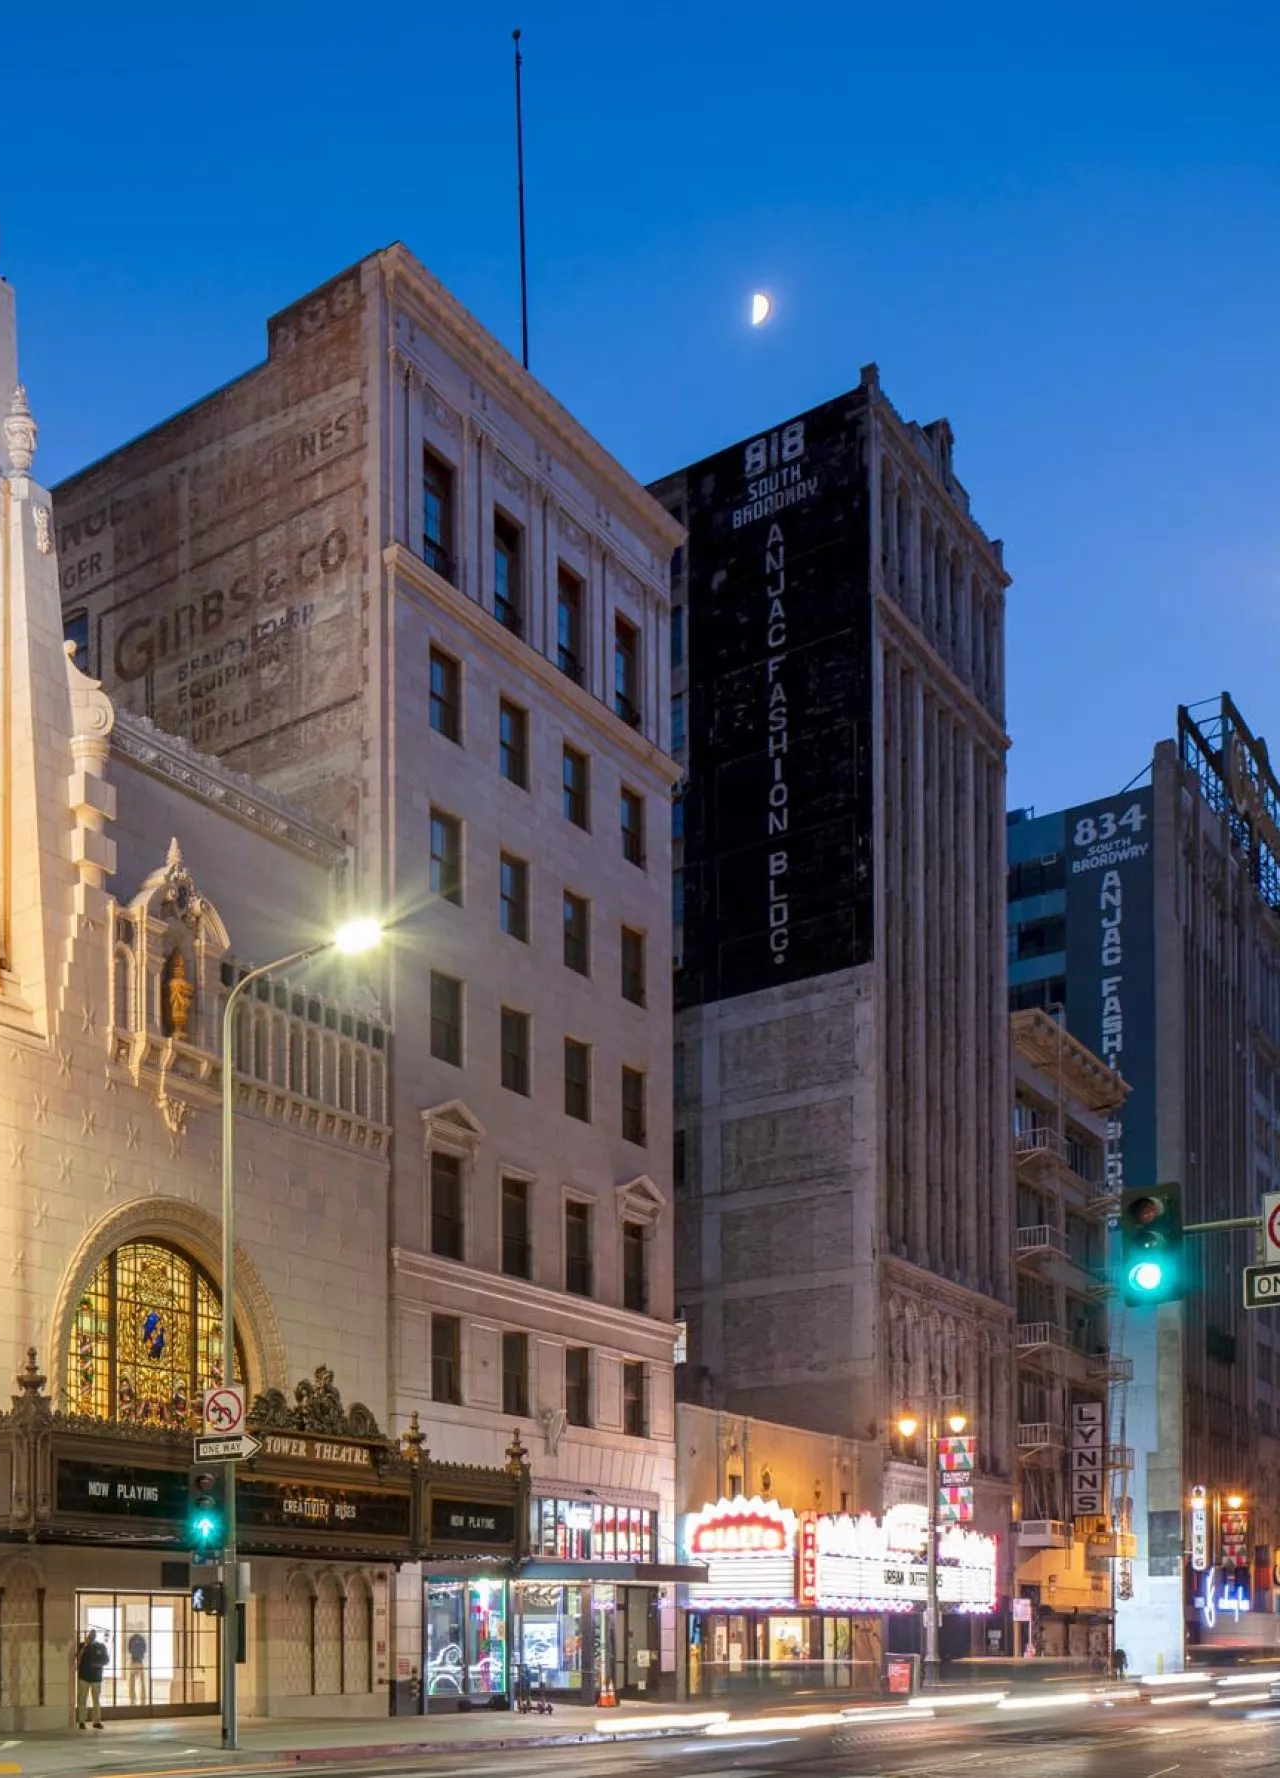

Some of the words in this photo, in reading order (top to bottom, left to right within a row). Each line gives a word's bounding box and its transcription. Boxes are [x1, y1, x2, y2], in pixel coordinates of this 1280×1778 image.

[744, 420, 805, 479] 818
[732, 475, 819, 529] BROADWAY
[747, 463, 802, 502] SOUTH
[765, 522, 786, 649] ANJAC
[767, 655, 789, 834] FASHION
[1073, 803, 1148, 846] 834
[1072, 842, 1149, 874] BROADWAY
[1087, 836, 1132, 856] SOUTH
[1100, 870, 1123, 967] ANJAC
[202, 1444, 220, 1455] ONE
[223, 1442, 242, 1454] WAY
[265, 1435, 307, 1458] TOWER
[314, 1442, 370, 1465] THEATRE
[1077, 1405, 1097, 1511] LYNNS
[88, 1481, 110, 1497] NOW
[117, 1484, 158, 1502] PLAYING
[282, 1498, 330, 1518] CREATIVITY
[803, 1521, 816, 1597] RIALTO
[883, 1568, 904, 1585] URBAN
